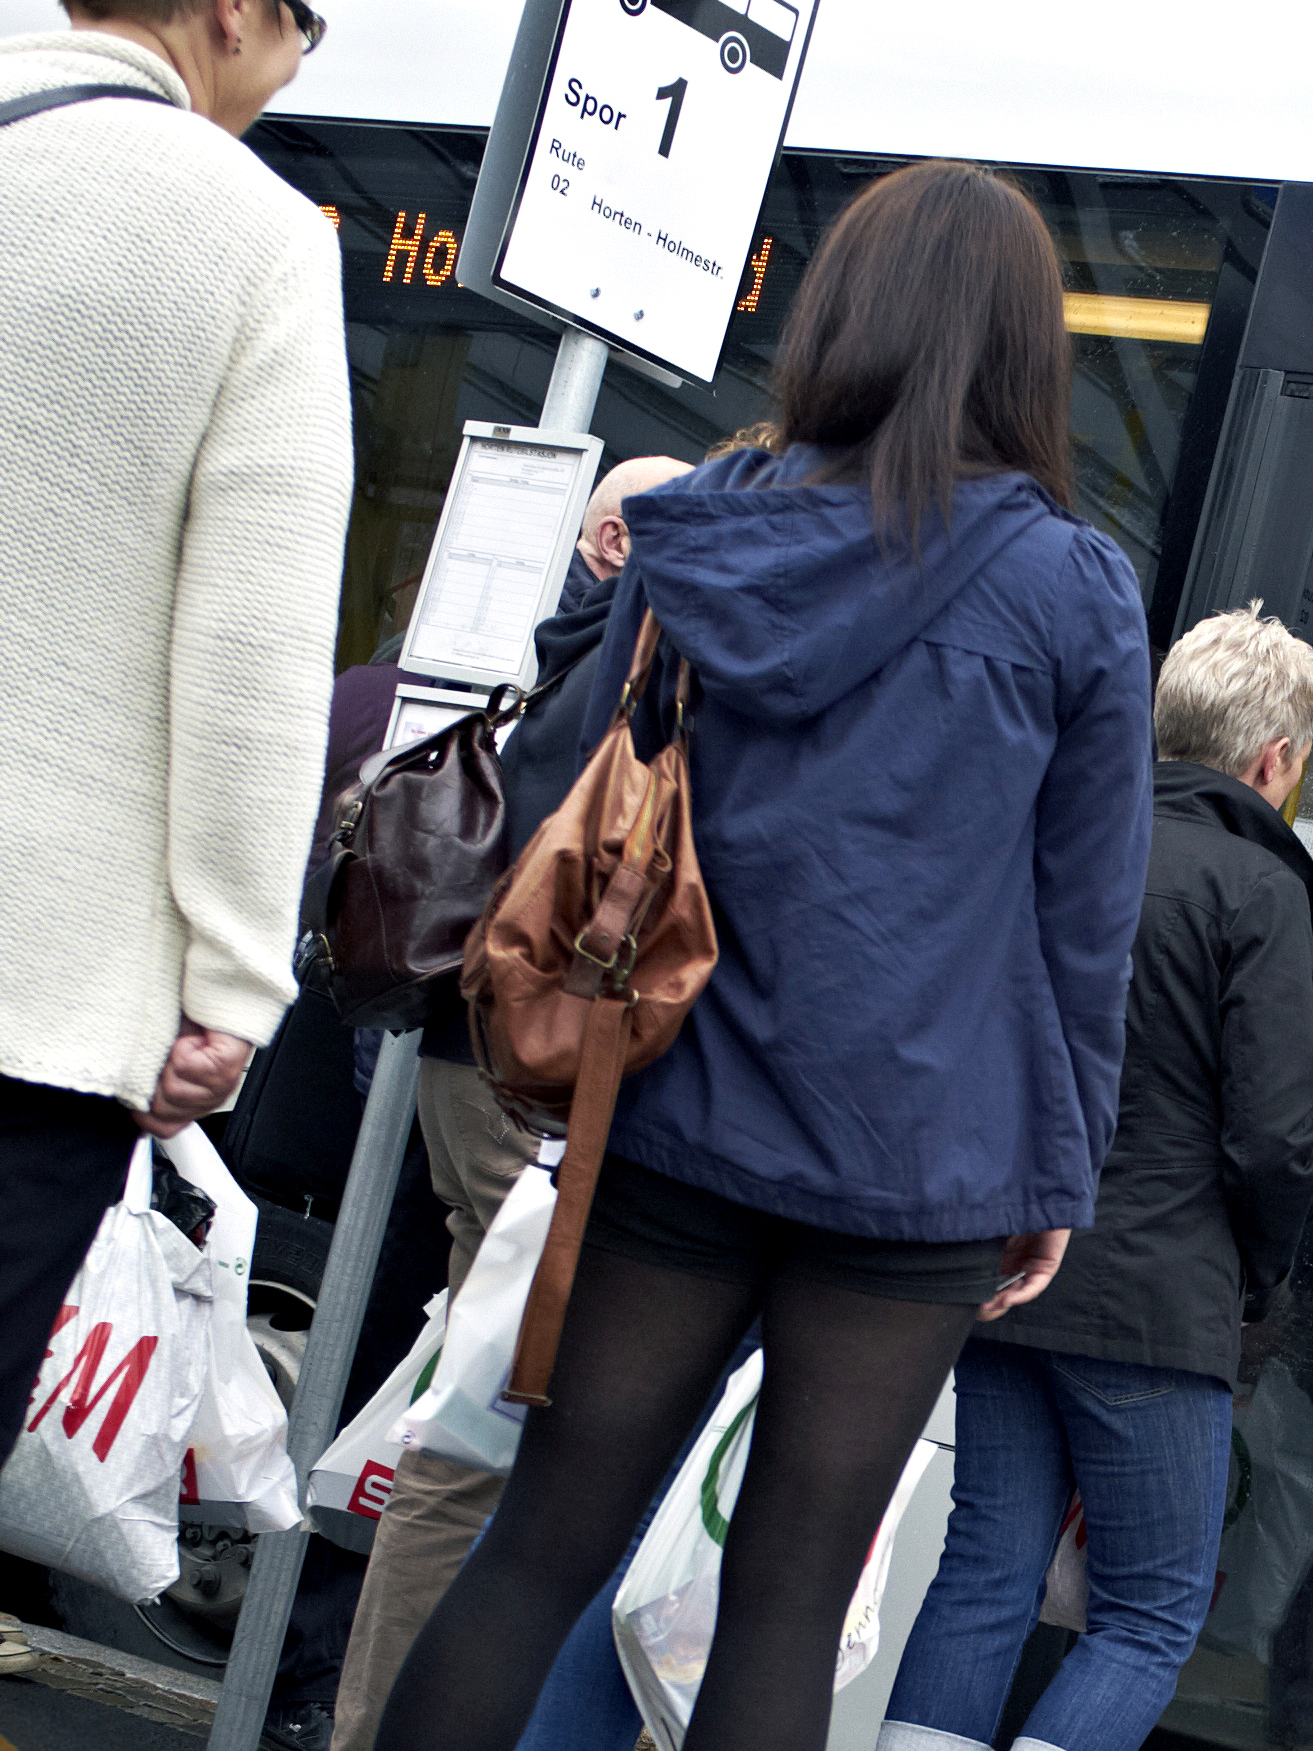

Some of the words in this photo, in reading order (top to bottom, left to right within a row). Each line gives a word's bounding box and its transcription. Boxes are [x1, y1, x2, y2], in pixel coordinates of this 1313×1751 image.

[564, 77, 627, 131] Spor
[655, 76, 689, 160] 1
[549, 138, 586, 171] Rute
[551, 174, 571, 197] 02
[591, 194, 642, 236] Horten
[655, 230, 723, 280] Holmestr.
